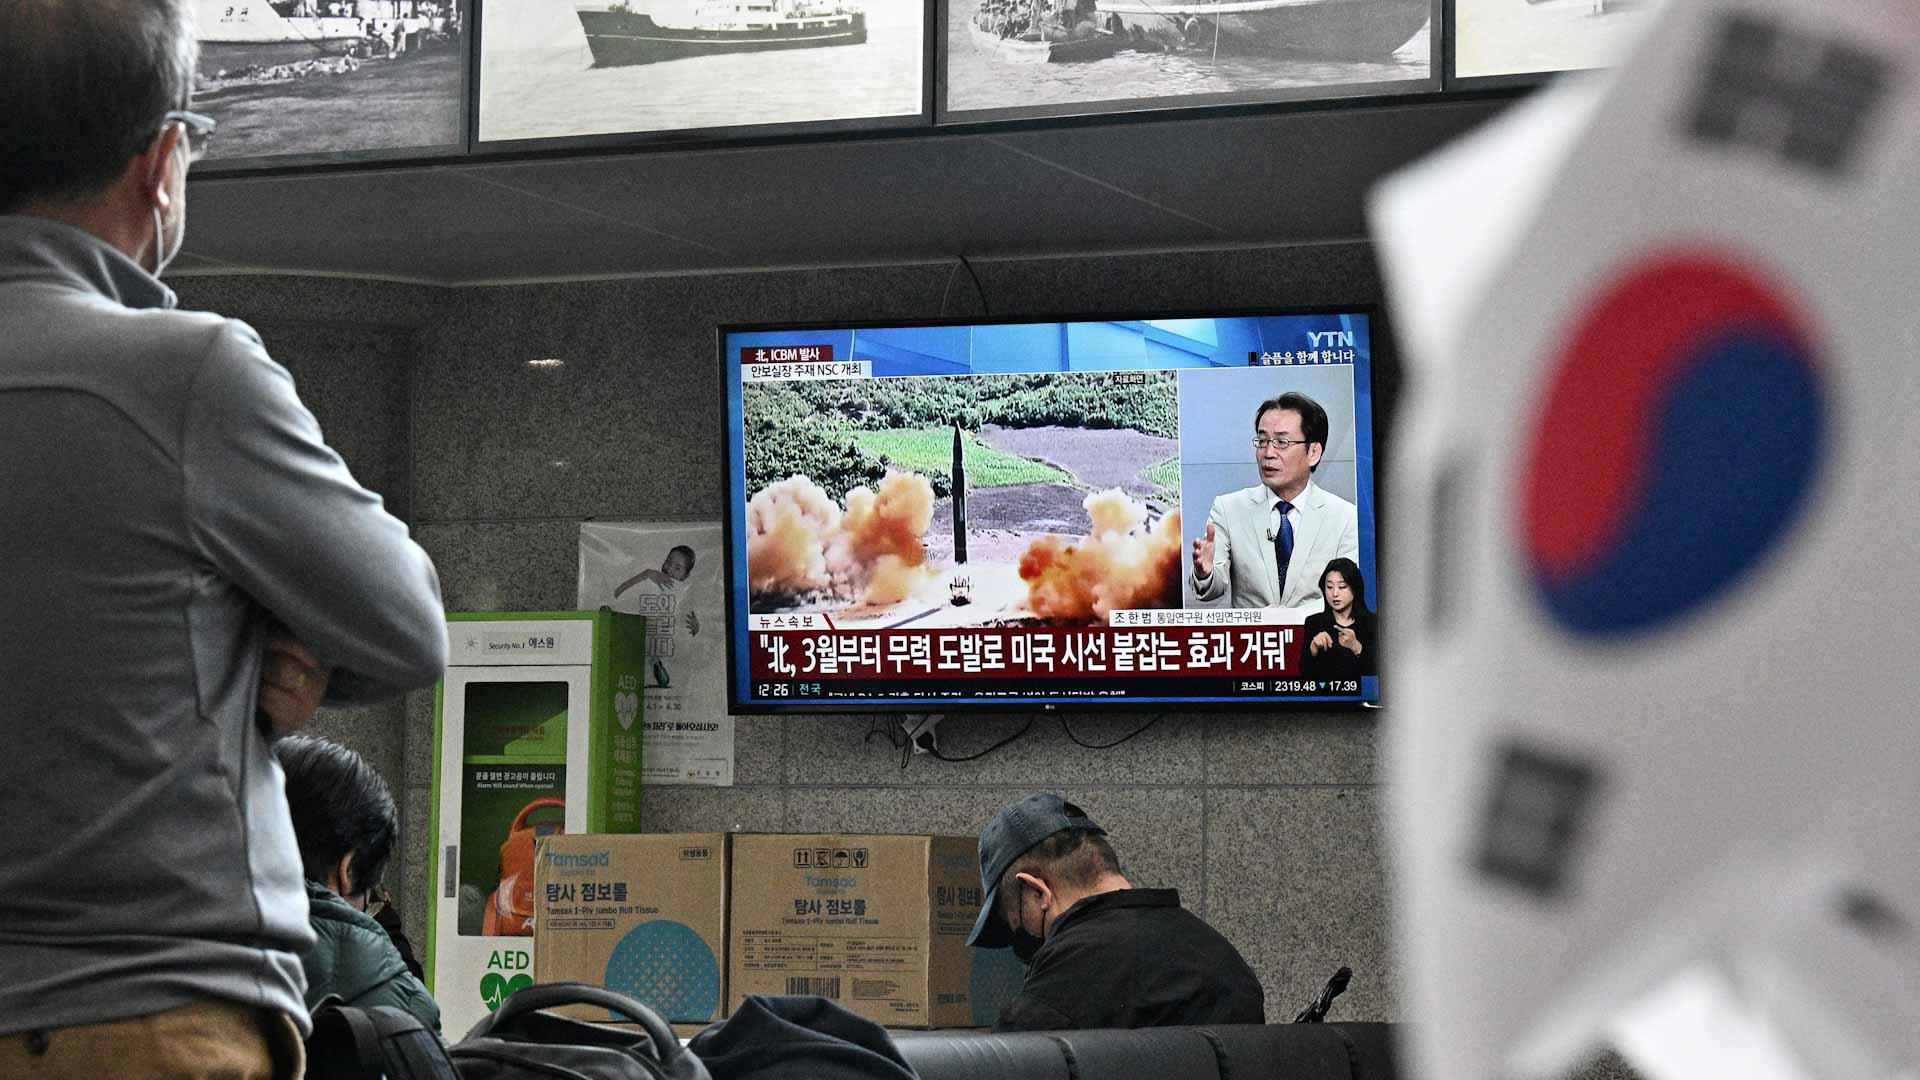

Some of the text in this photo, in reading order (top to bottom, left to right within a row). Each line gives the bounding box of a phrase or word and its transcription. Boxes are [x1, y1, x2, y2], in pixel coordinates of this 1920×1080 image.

[1307, 331, 1354, 348] YTN
[771, 348, 797, 361] ICBM
[800, 347, 820, 361] 발사
[1260, 349, 1355, 364] 슬픔을 함께 합니다
[751, 362, 862, 378] 안보실장 주재 NSC 개최
[759, 616, 814, 628] 뉴스속보
[1156, 611, 1203, 624] 통일연구원
[1205, 611, 1262, 624] 선임연구위원
[488, 642, 511, 650] Security
[528, 637, 554, 649] 에스원
[801, 635, 881, 674] 3월부터
[887, 634, 932, 673] 무력
[938, 633, 1006, 673] 도발로
[1011, 633, 1055, 673] 미국
[1061, 632, 1106, 673] 시선
[1112, 631, 1180, 672] 붙잡는
[1187, 631, 1234, 671] 효과
[1239, 628, 1294, 671] 거둬"
[617, 675, 636, 690] AED
[758, 683, 789, 697] 12:26
[799, 683, 822, 696] 전국
[1240, 680, 1358, 692] 코스피 2319.48 17.39
[546, 882, 628, 902] 탐사 점보롤
[794, 899, 866, 916] 탐사 점보롤
[487, 950, 530, 970] AED
